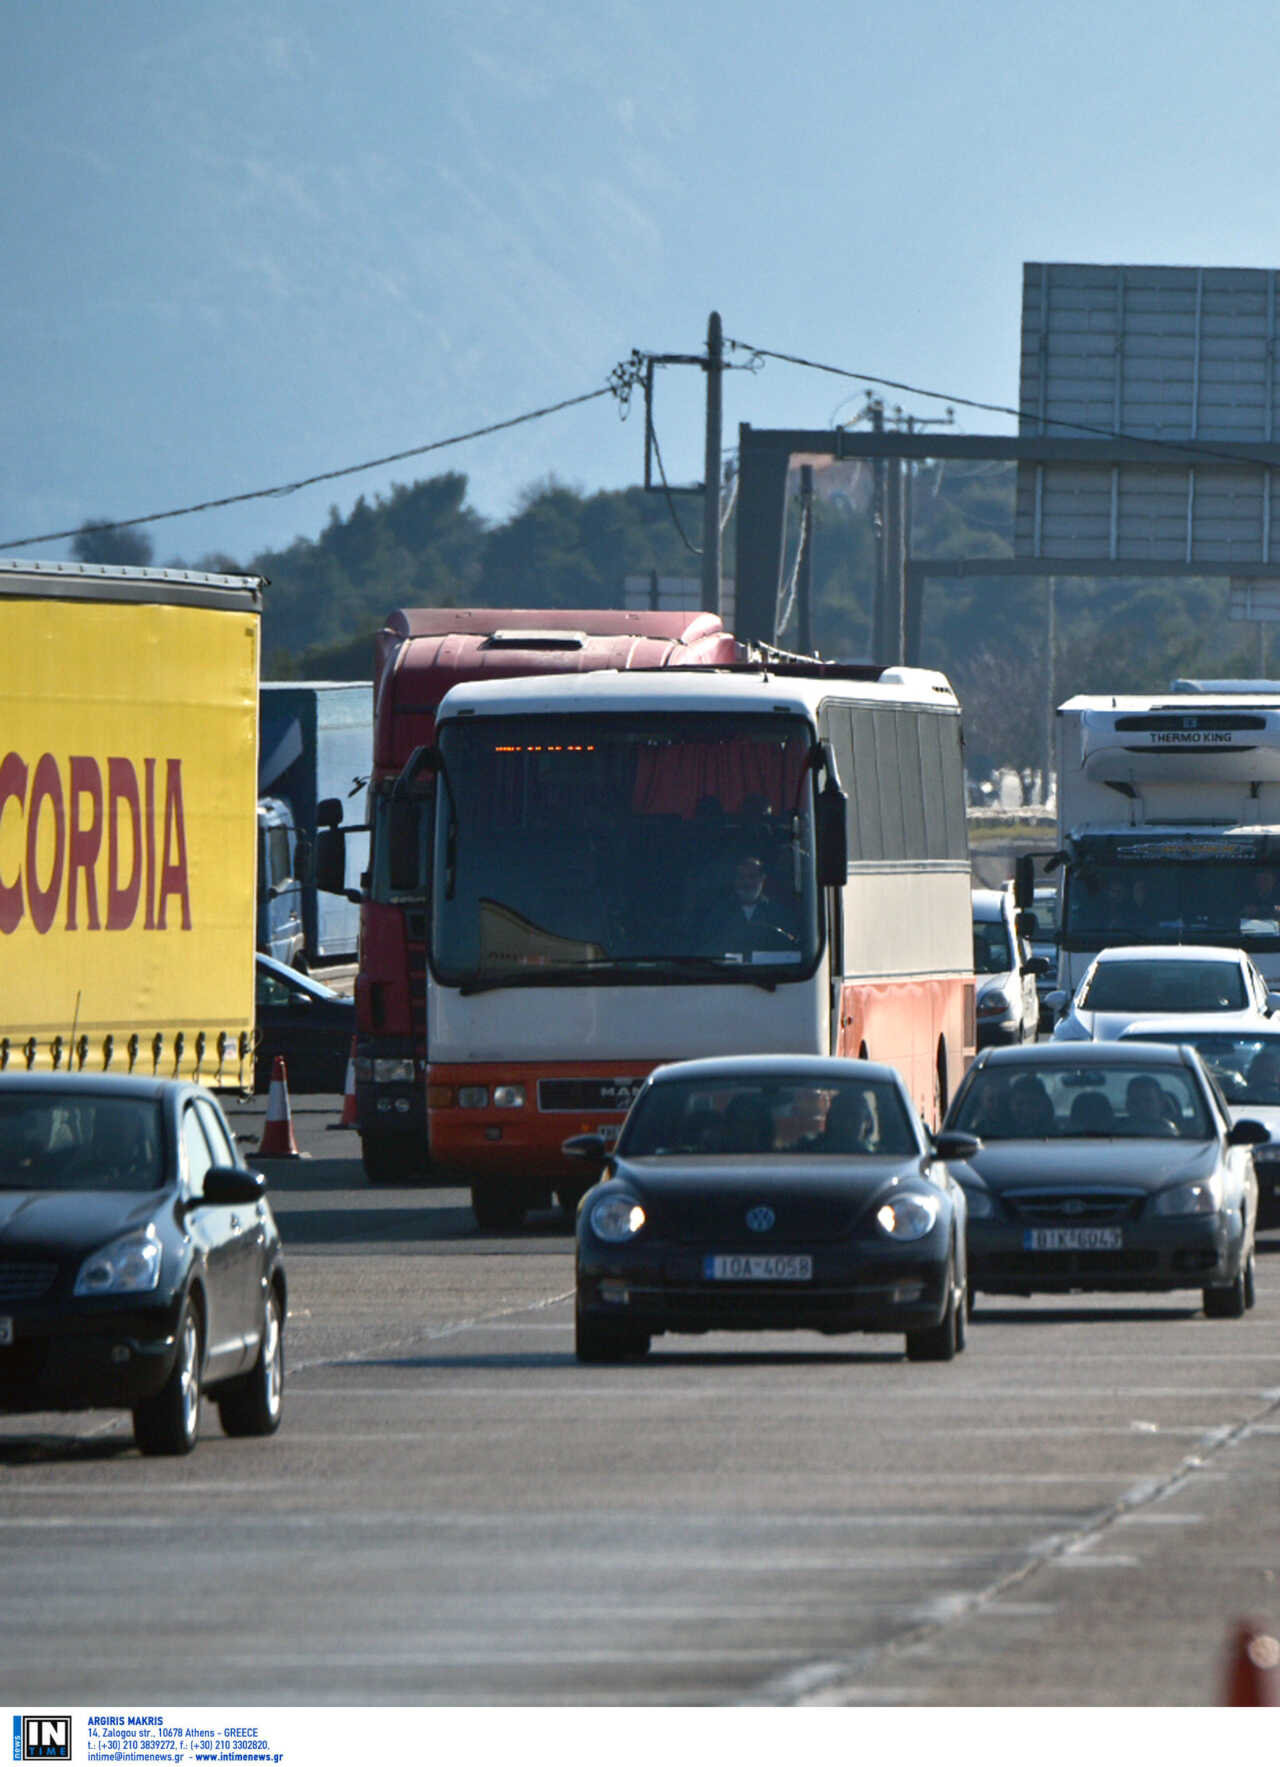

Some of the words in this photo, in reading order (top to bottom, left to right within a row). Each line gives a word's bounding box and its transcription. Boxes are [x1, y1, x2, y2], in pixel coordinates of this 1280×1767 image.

[1150, 733, 1201, 743] THERMO
[1202, 732, 1232, 743] KING
[0, 751, 192, 935] CORDIA
